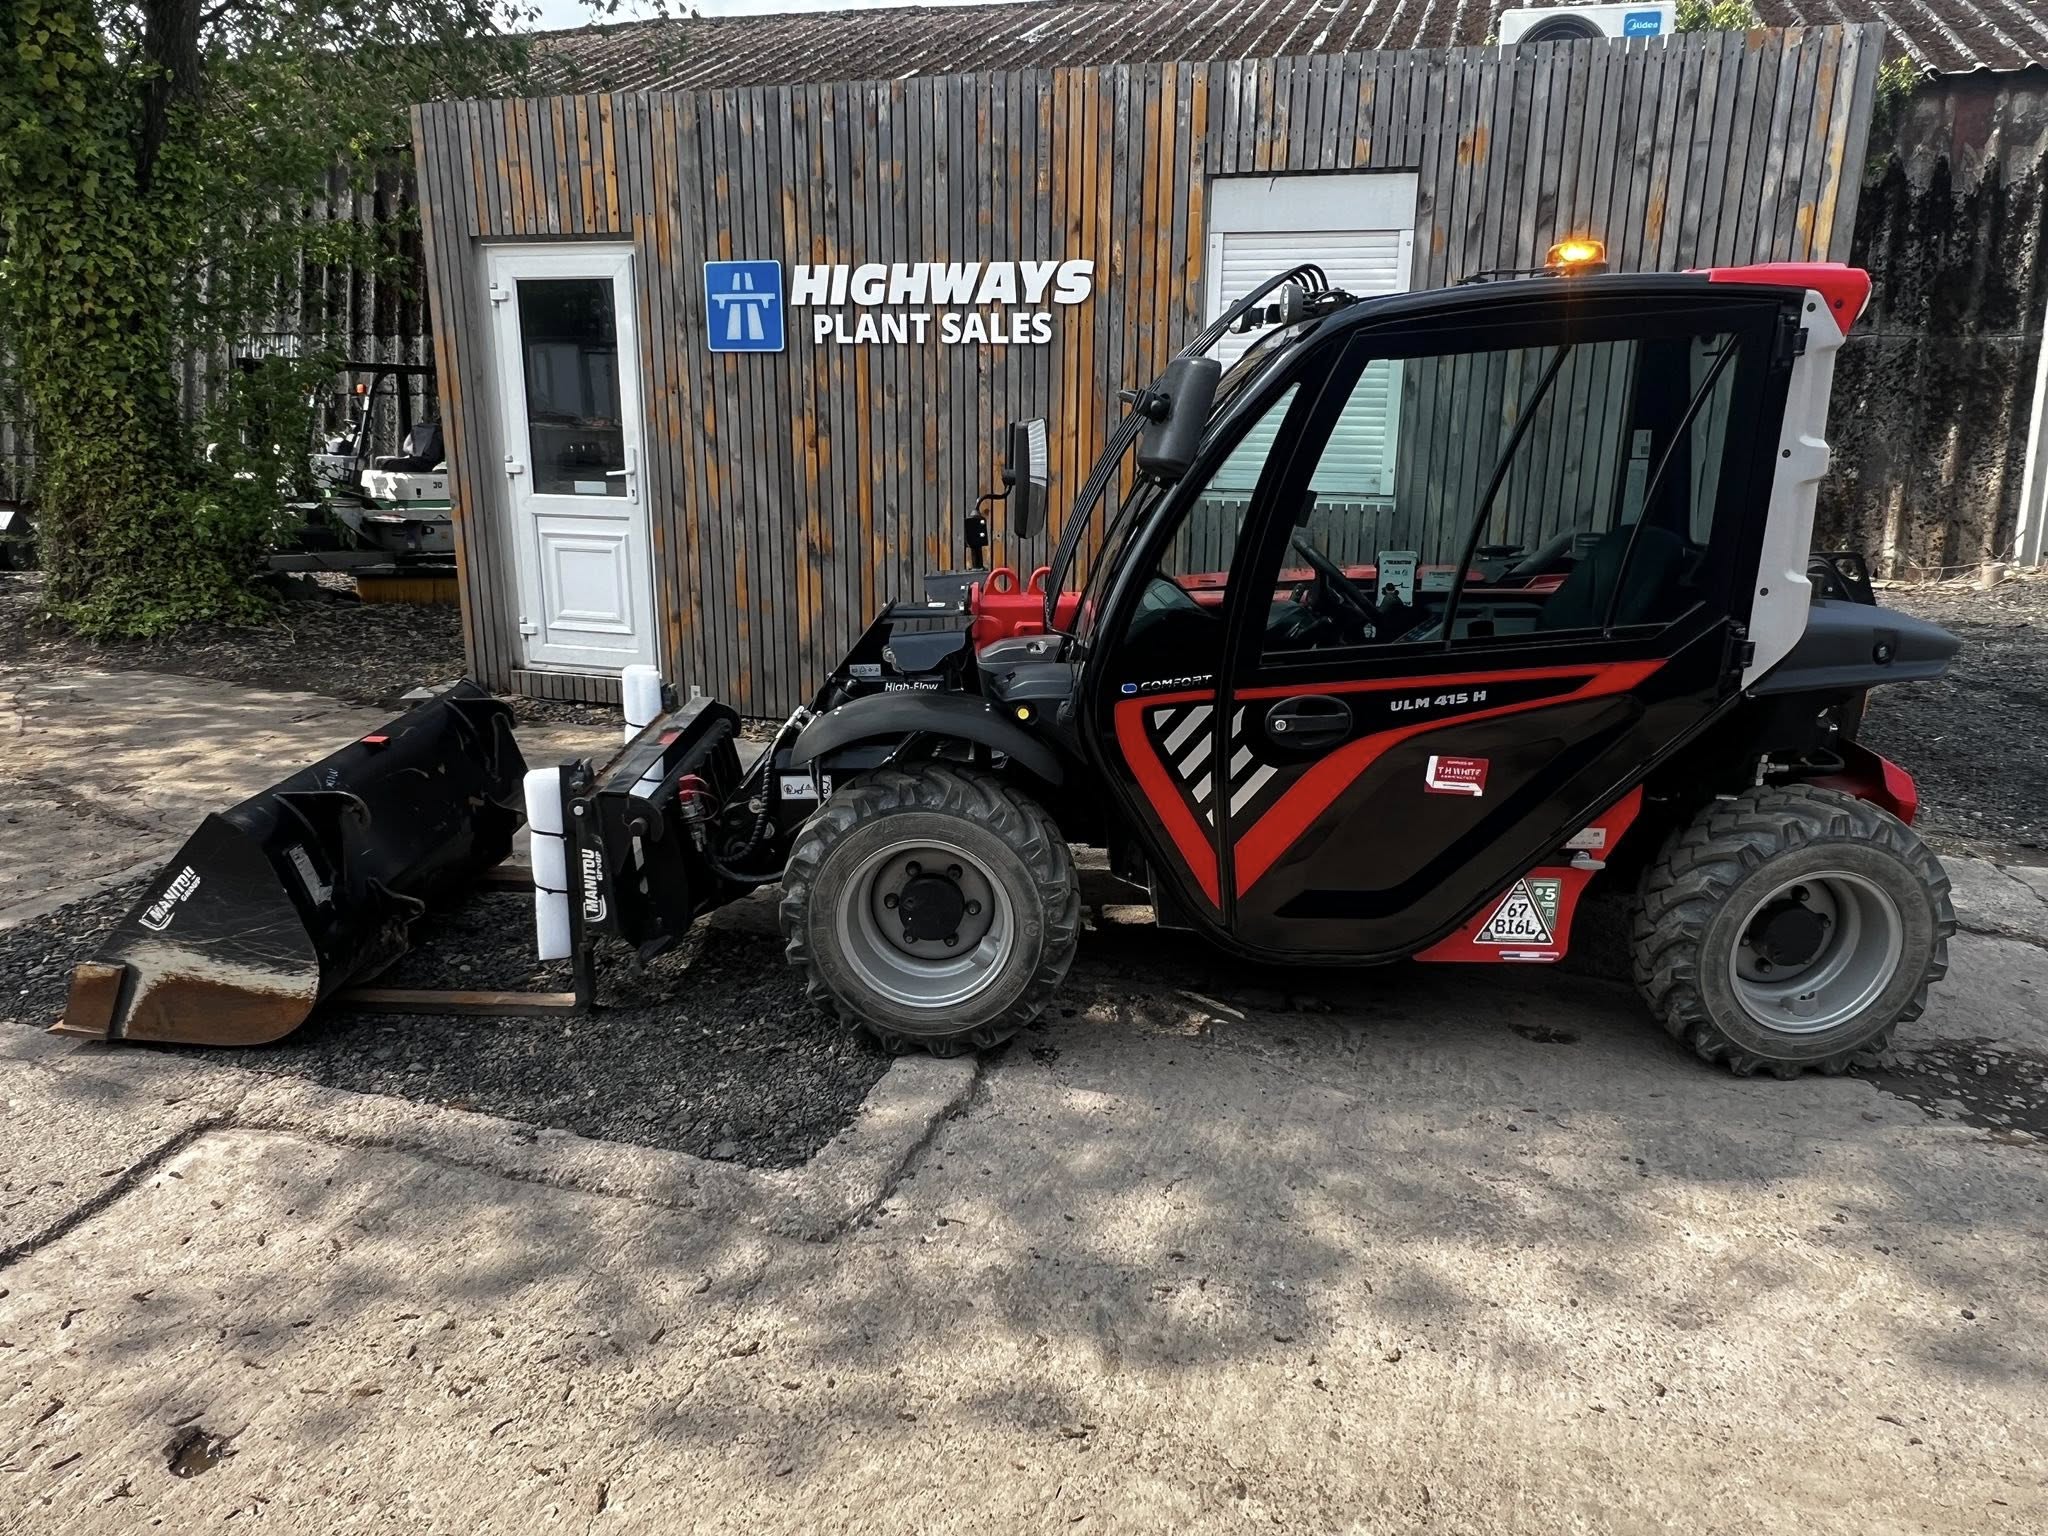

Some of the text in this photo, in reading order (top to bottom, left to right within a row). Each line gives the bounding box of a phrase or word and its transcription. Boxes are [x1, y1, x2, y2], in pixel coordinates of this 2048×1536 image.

[1628, 20, 1658, 30] Midea
[791, 259, 1094, 306] HIGHWAYS
[813, 312, 1051, 344] PLANT SALES
[1141, 674, 1212, 690] COMFORT
[1390, 690, 1487, 711] ULM 415 H
[181, 876, 200, 901] GROUP
[582, 849, 599, 912] MANITOU
[149, 866, 196, 921] MANITOU
[1507, 903, 1528, 918] 67
